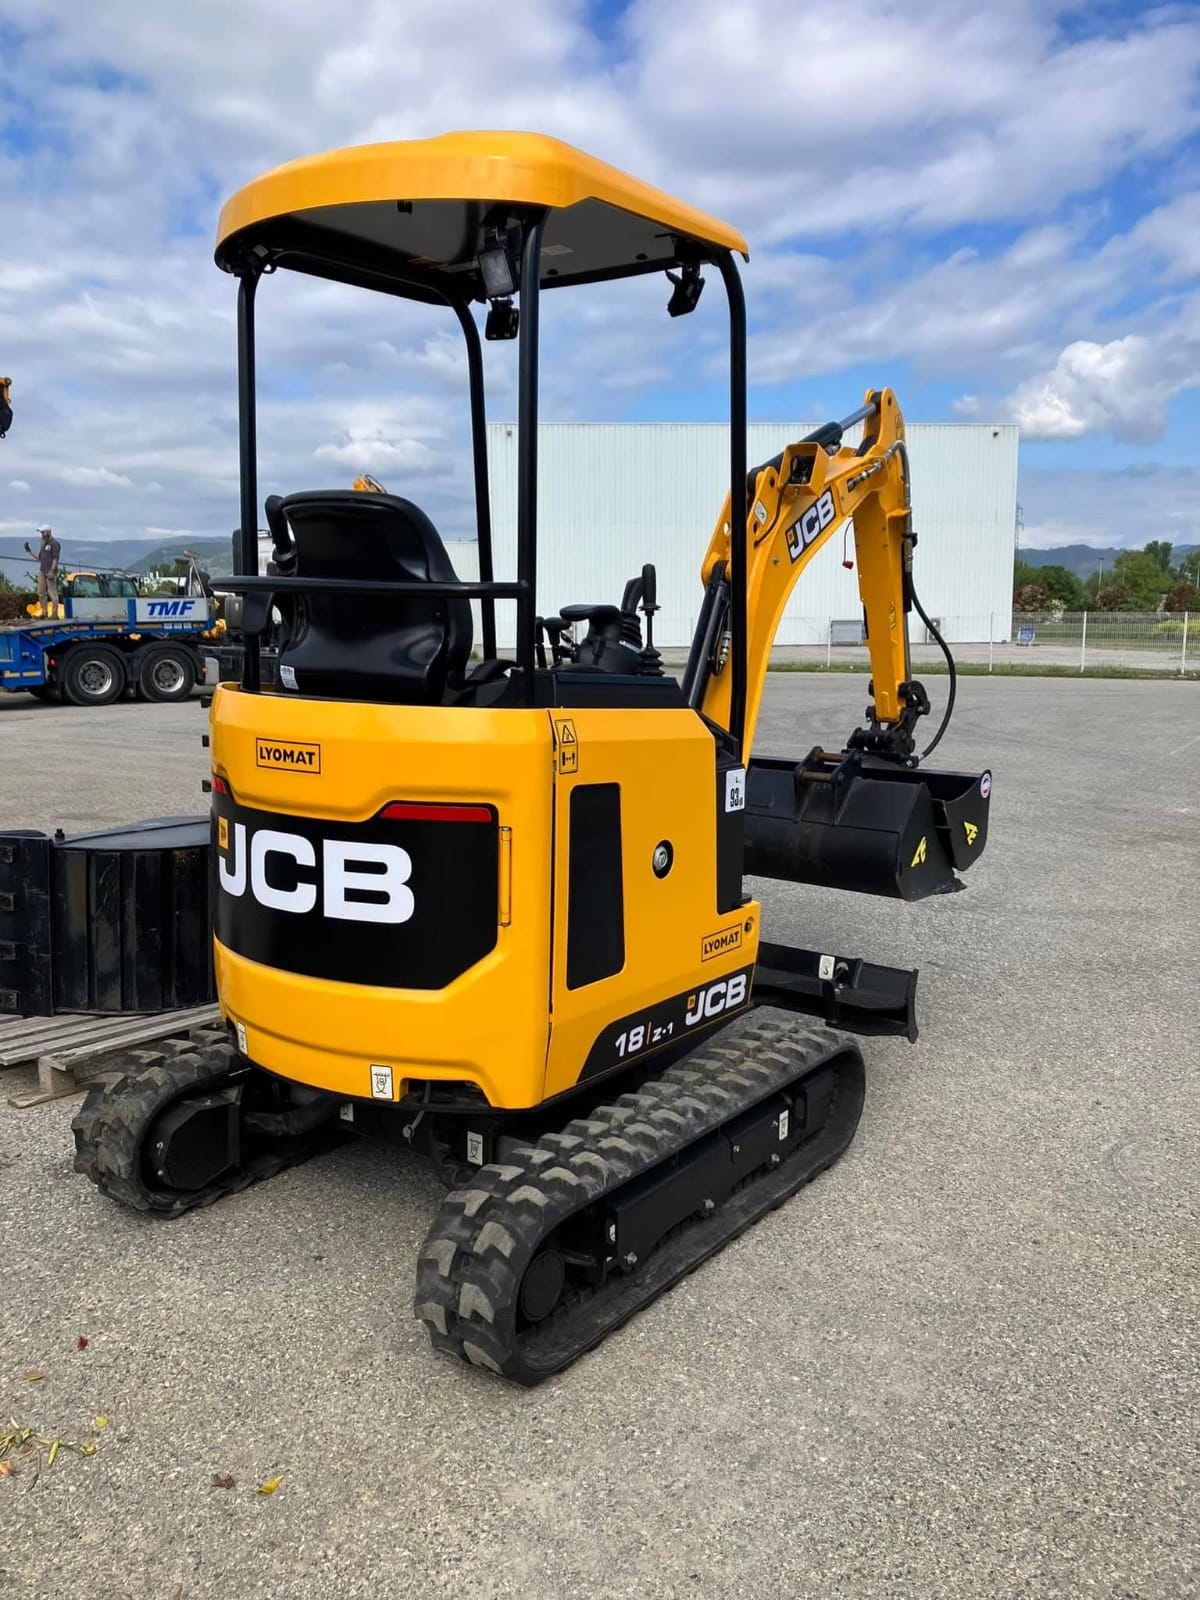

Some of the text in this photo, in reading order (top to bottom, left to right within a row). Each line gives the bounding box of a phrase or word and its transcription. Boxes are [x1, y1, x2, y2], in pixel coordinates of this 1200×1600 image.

[789, 491, 836, 560] JCB
[147, 600, 196, 616] TMF
[260, 745, 315, 766] LYOMAT
[219, 822, 415, 924] JCB
[704, 931, 739, 955] LYOMAT
[685, 973, 747, 1026] JCB
[615, 1025, 645, 1057] 18
